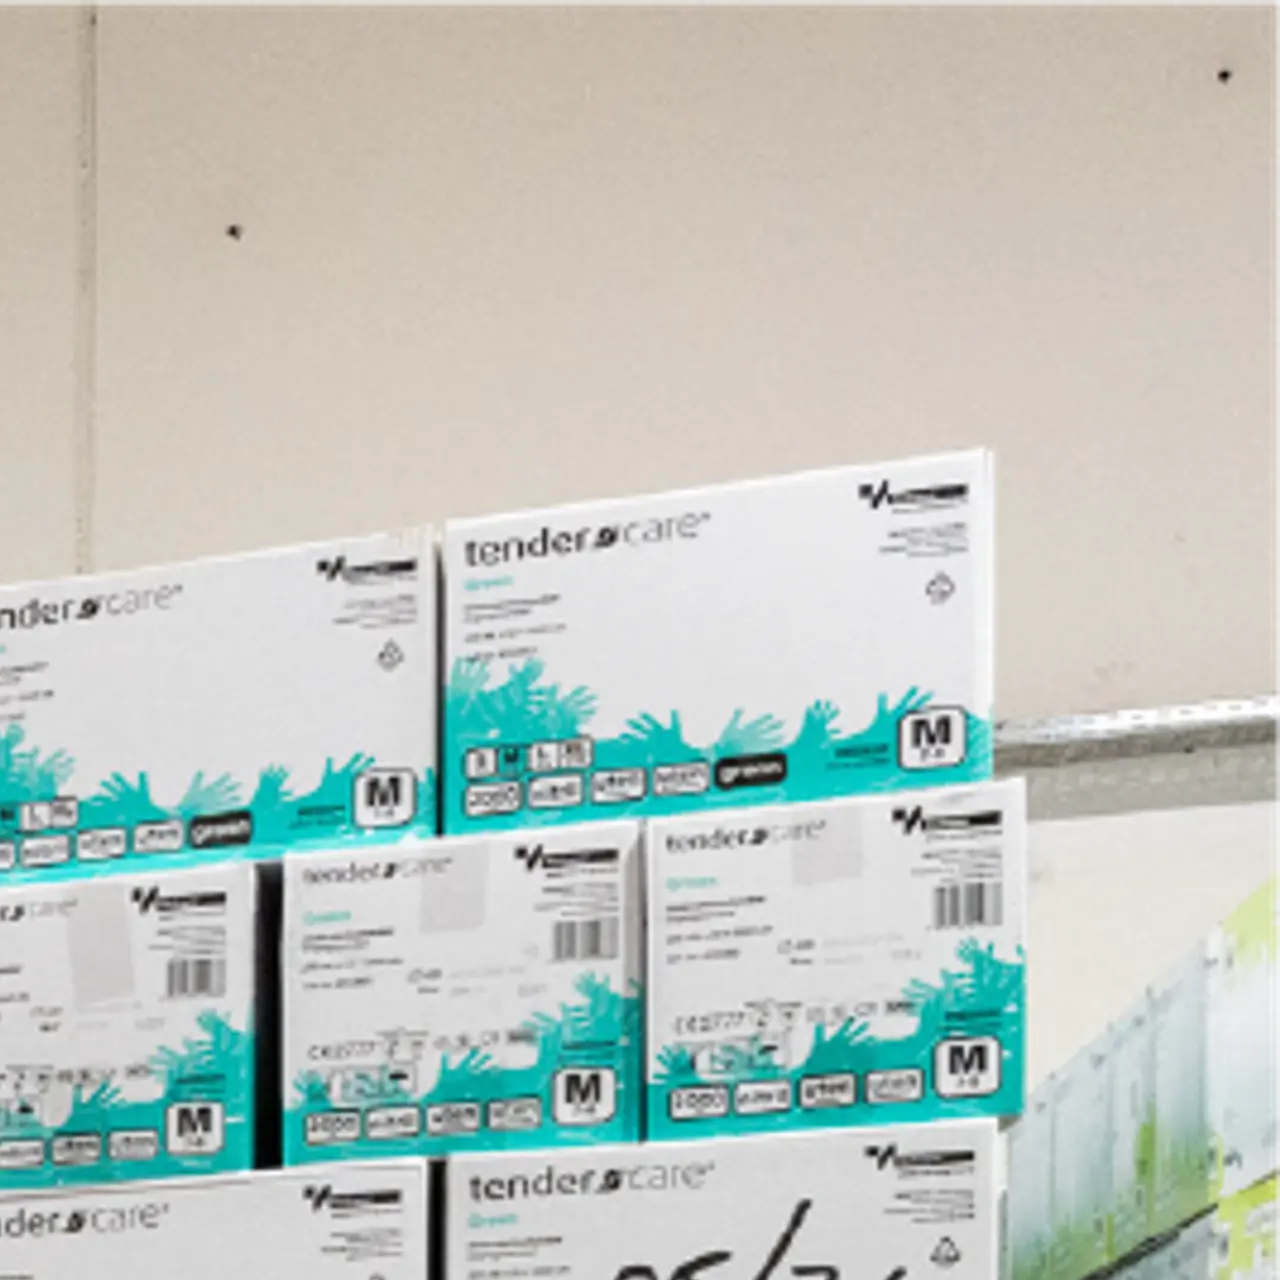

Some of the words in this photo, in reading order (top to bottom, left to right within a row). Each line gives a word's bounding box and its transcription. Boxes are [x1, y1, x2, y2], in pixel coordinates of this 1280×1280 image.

[465, 527, 586, 567] tender
[913, 716, 951, 747] M
[367, 776, 400, 806] M
[949, 1045, 986, 1074] M
[566, 1073, 601, 1103] M
[178, 1107, 211, 1135] M
[469, 1166, 593, 1201] tender
